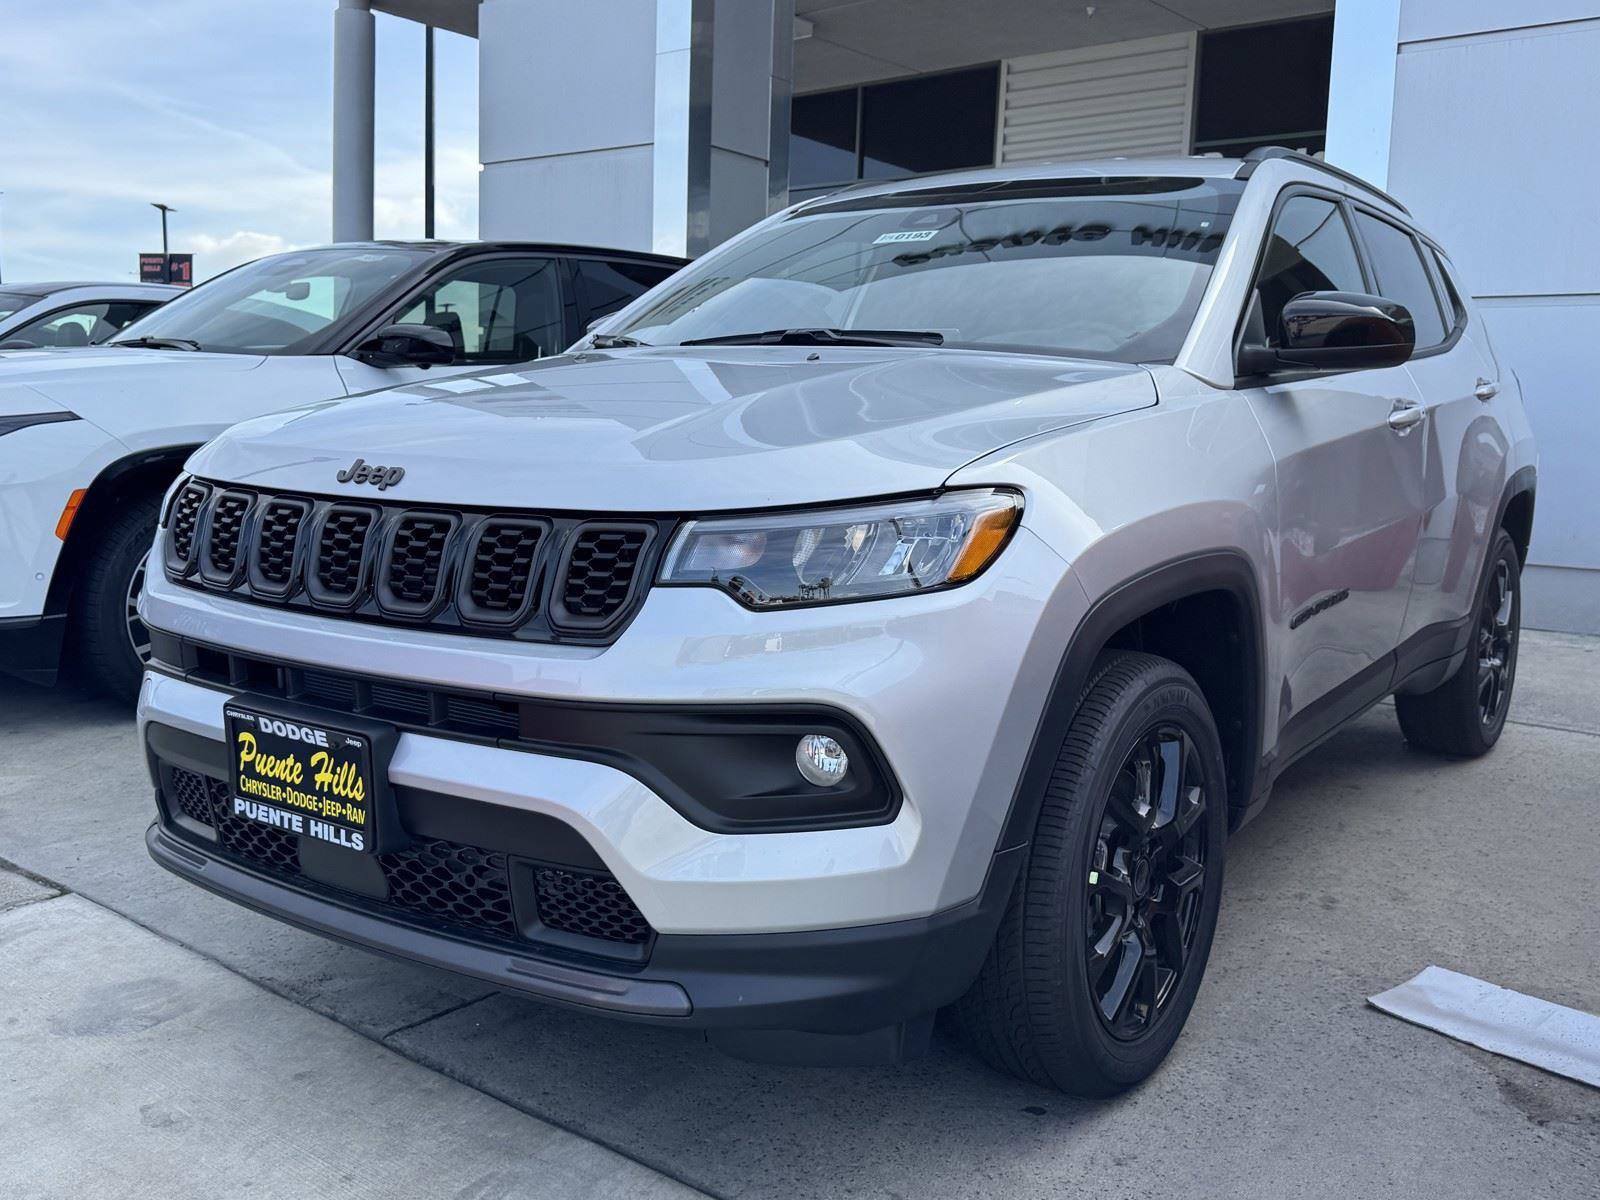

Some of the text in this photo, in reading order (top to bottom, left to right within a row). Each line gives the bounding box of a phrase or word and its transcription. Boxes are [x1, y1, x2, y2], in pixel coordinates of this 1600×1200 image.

[336, 458, 406, 491] Jeep
[259, 717, 329, 748] DODGE
[238, 731, 366, 802] Puente Hills
[234, 798, 365, 851] PUENTE HILLS
